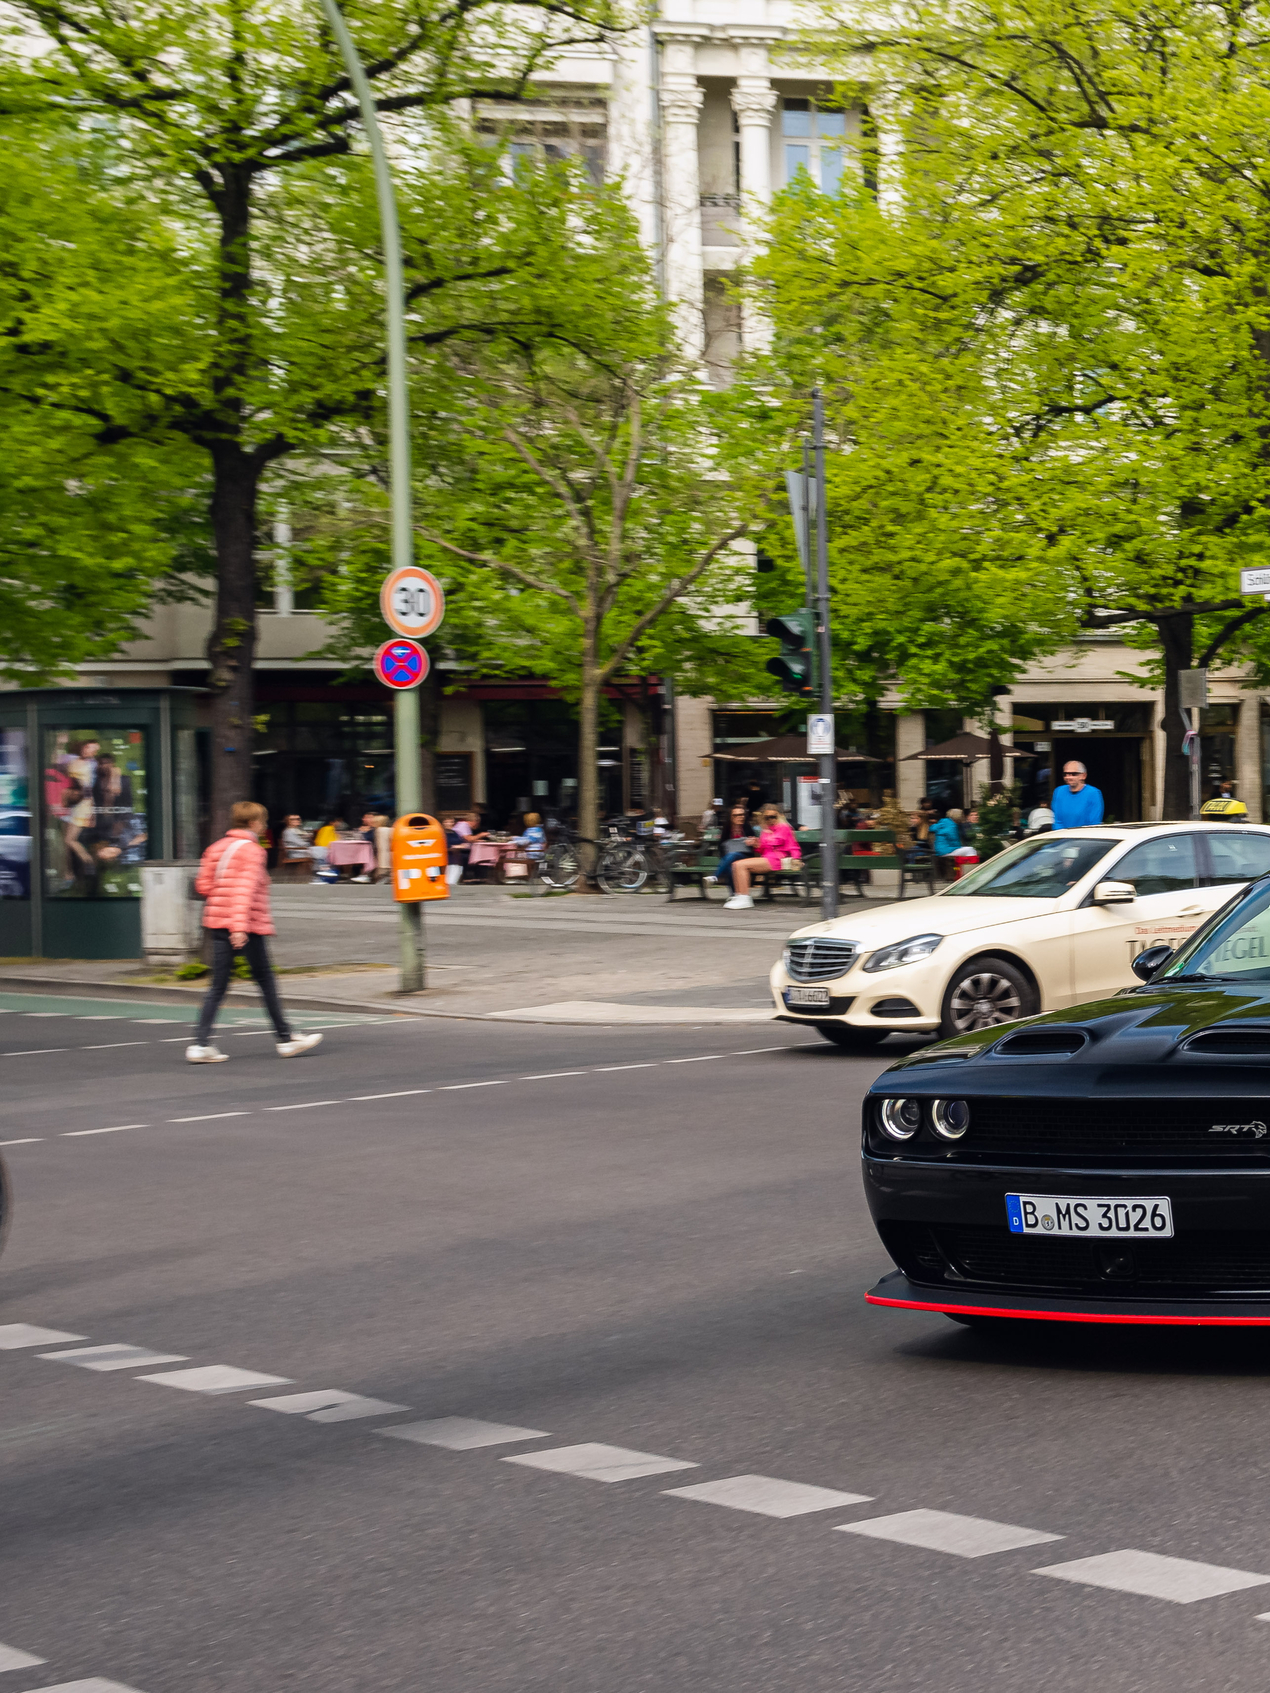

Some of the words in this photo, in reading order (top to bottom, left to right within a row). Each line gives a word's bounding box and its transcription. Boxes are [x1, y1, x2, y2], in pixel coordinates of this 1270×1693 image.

[394, 586, 431, 618] 30
[1208, 1125, 1255, 1134] SRT
[1012, 1217, 1020, 1226] D
[1022, 1200, 1040, 1229] B
[1054, 1202, 1090, 1232] MS
[1096, 1203, 1167, 1232] 3026
